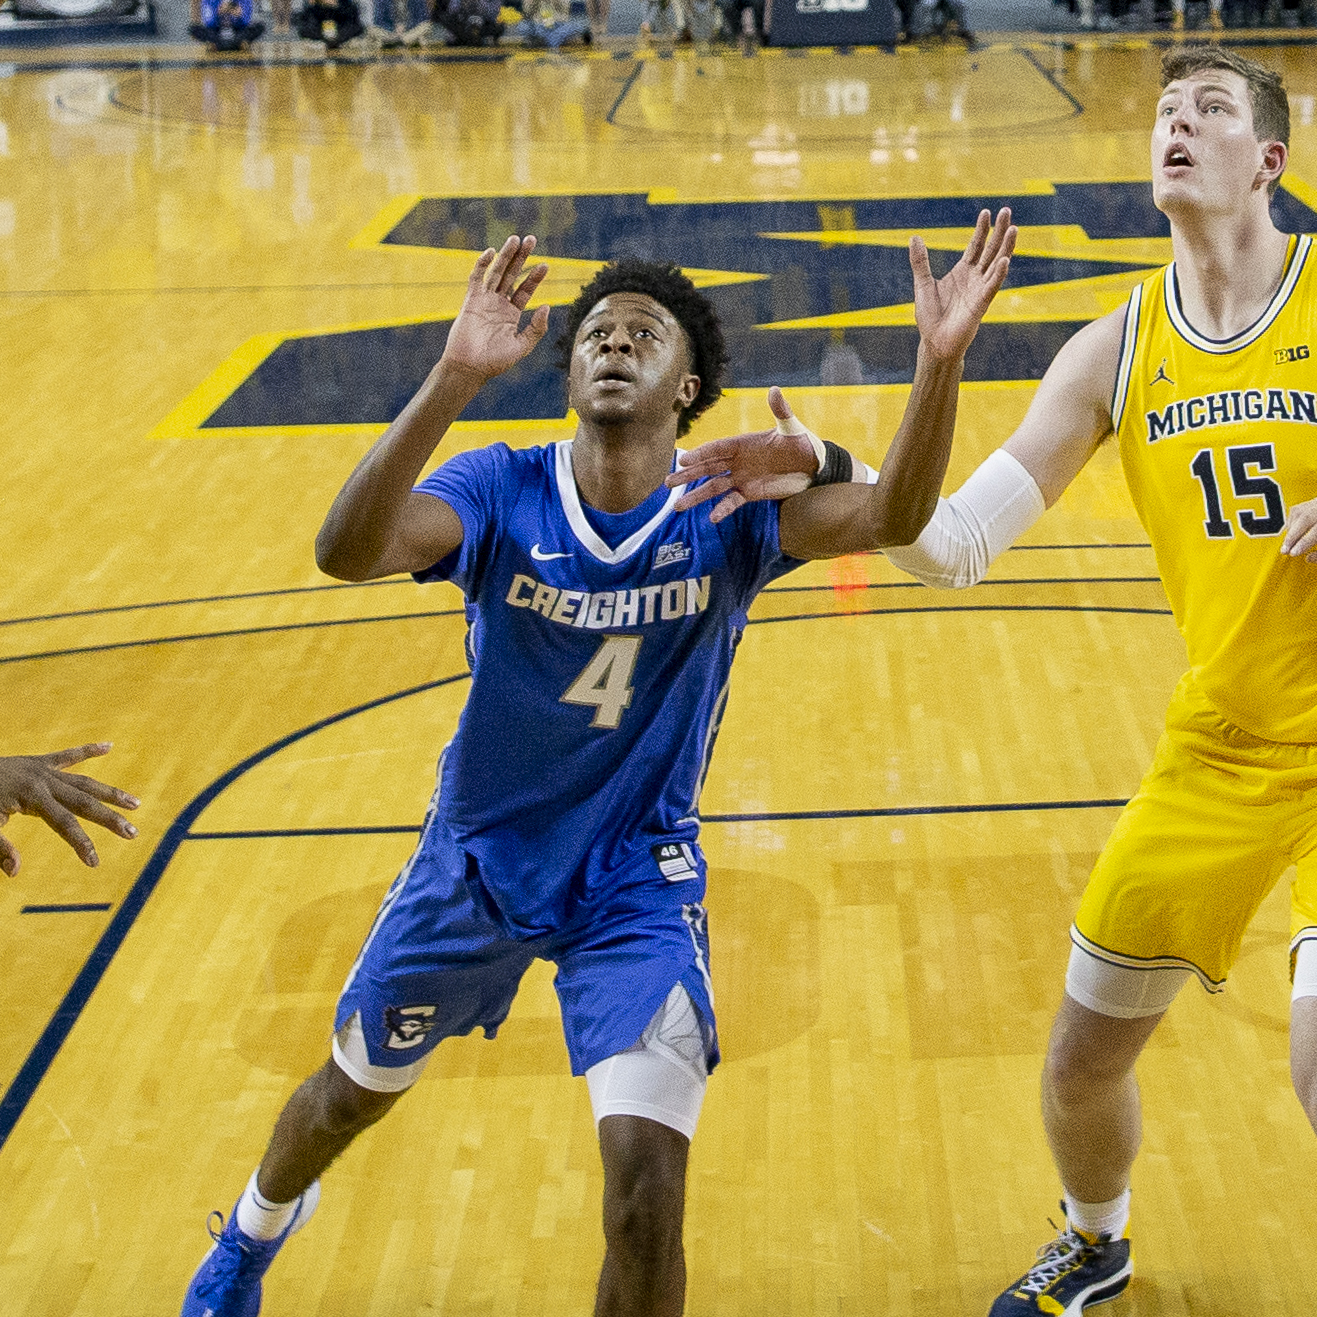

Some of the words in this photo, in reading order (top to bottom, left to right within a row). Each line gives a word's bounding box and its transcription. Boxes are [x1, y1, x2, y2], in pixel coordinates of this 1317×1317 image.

[1191, 443, 1287, 540] 15
[505, 574, 712, 629] CREIGHTON
[559, 633, 644, 730] 4
[661, 844, 679, 858] 46
